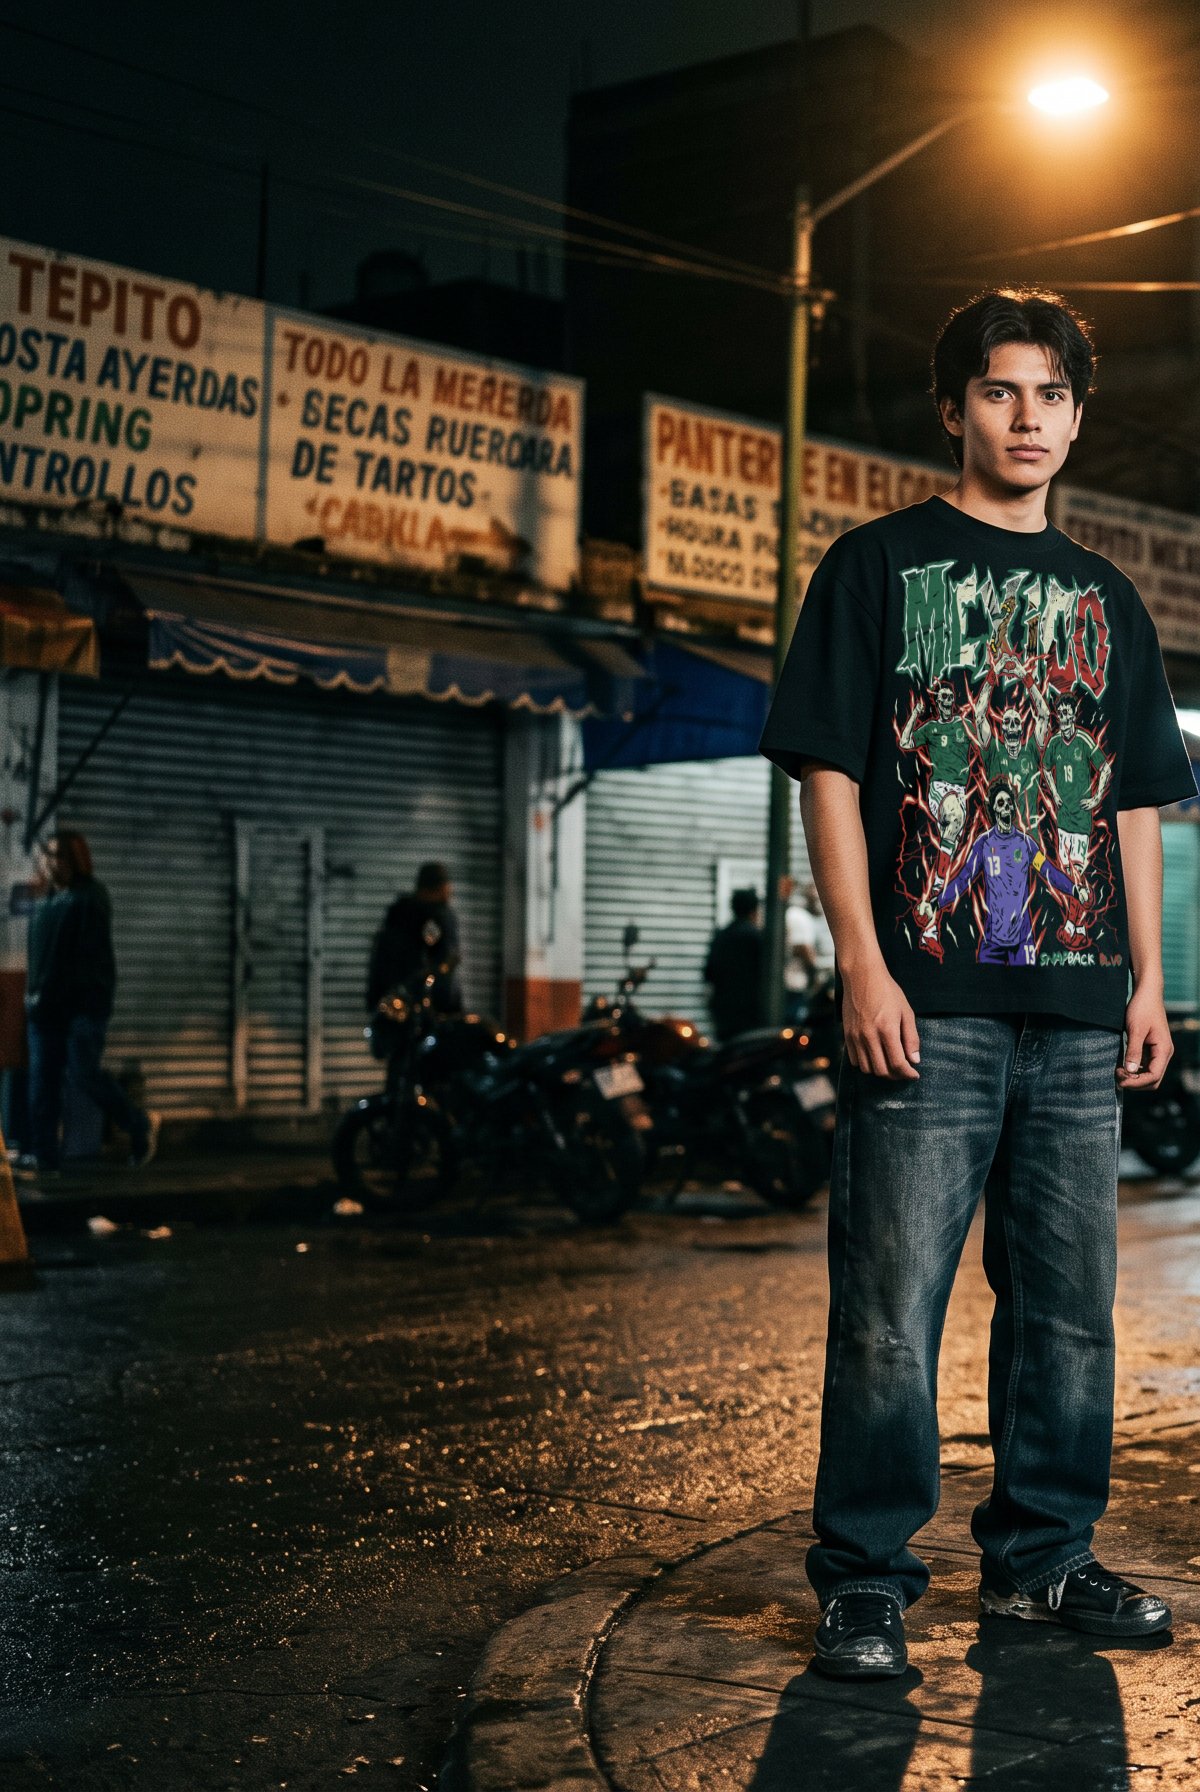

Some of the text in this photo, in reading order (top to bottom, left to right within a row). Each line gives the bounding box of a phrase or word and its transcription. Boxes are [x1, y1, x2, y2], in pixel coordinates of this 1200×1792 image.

[9, 252, 201, 350] TEPITO
[284, 331, 369, 387] TODO
[381, 353, 421, 400] LA
[97, 346, 259, 418] AYERDAS
[291, 438, 477, 509] DE TARTOS
[941, 735, 948, 747] 9
[1063, 764, 1073, 783] 19
[988, 855, 1001, 877] 13
[1024, 945, 1036, 965] 13
[1040, 951, 1095, 966] SNAPBACK
